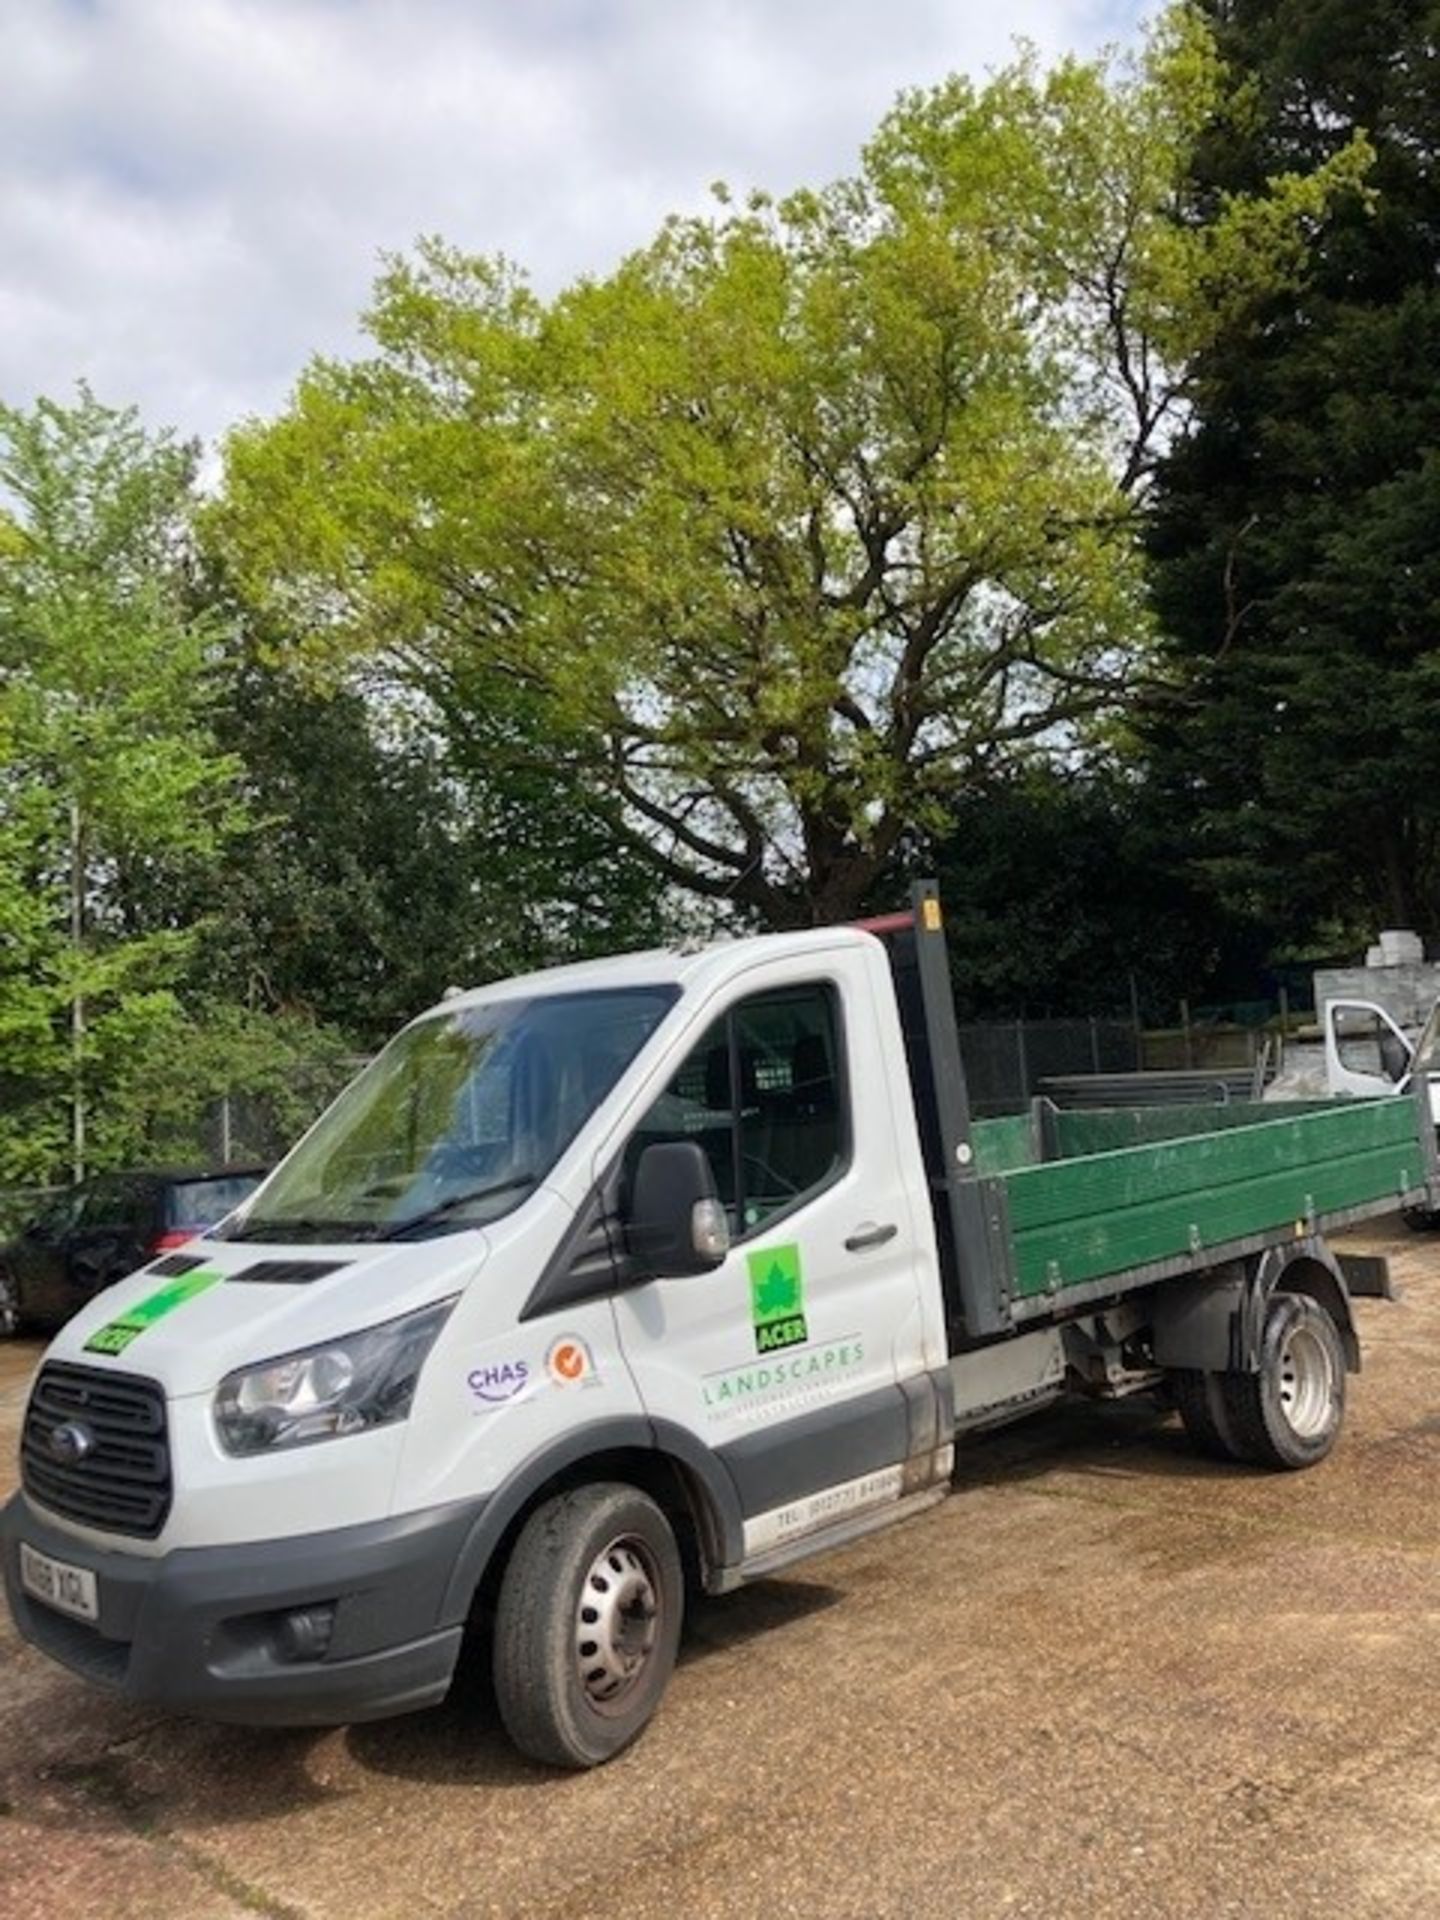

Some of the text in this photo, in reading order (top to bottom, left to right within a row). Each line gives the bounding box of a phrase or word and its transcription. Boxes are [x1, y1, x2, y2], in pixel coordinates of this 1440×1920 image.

[759, 1319, 807, 1348] ACER
[467, 1360, 528, 1390] CHAS
[701, 1343, 865, 1405] LANDSCAPES
